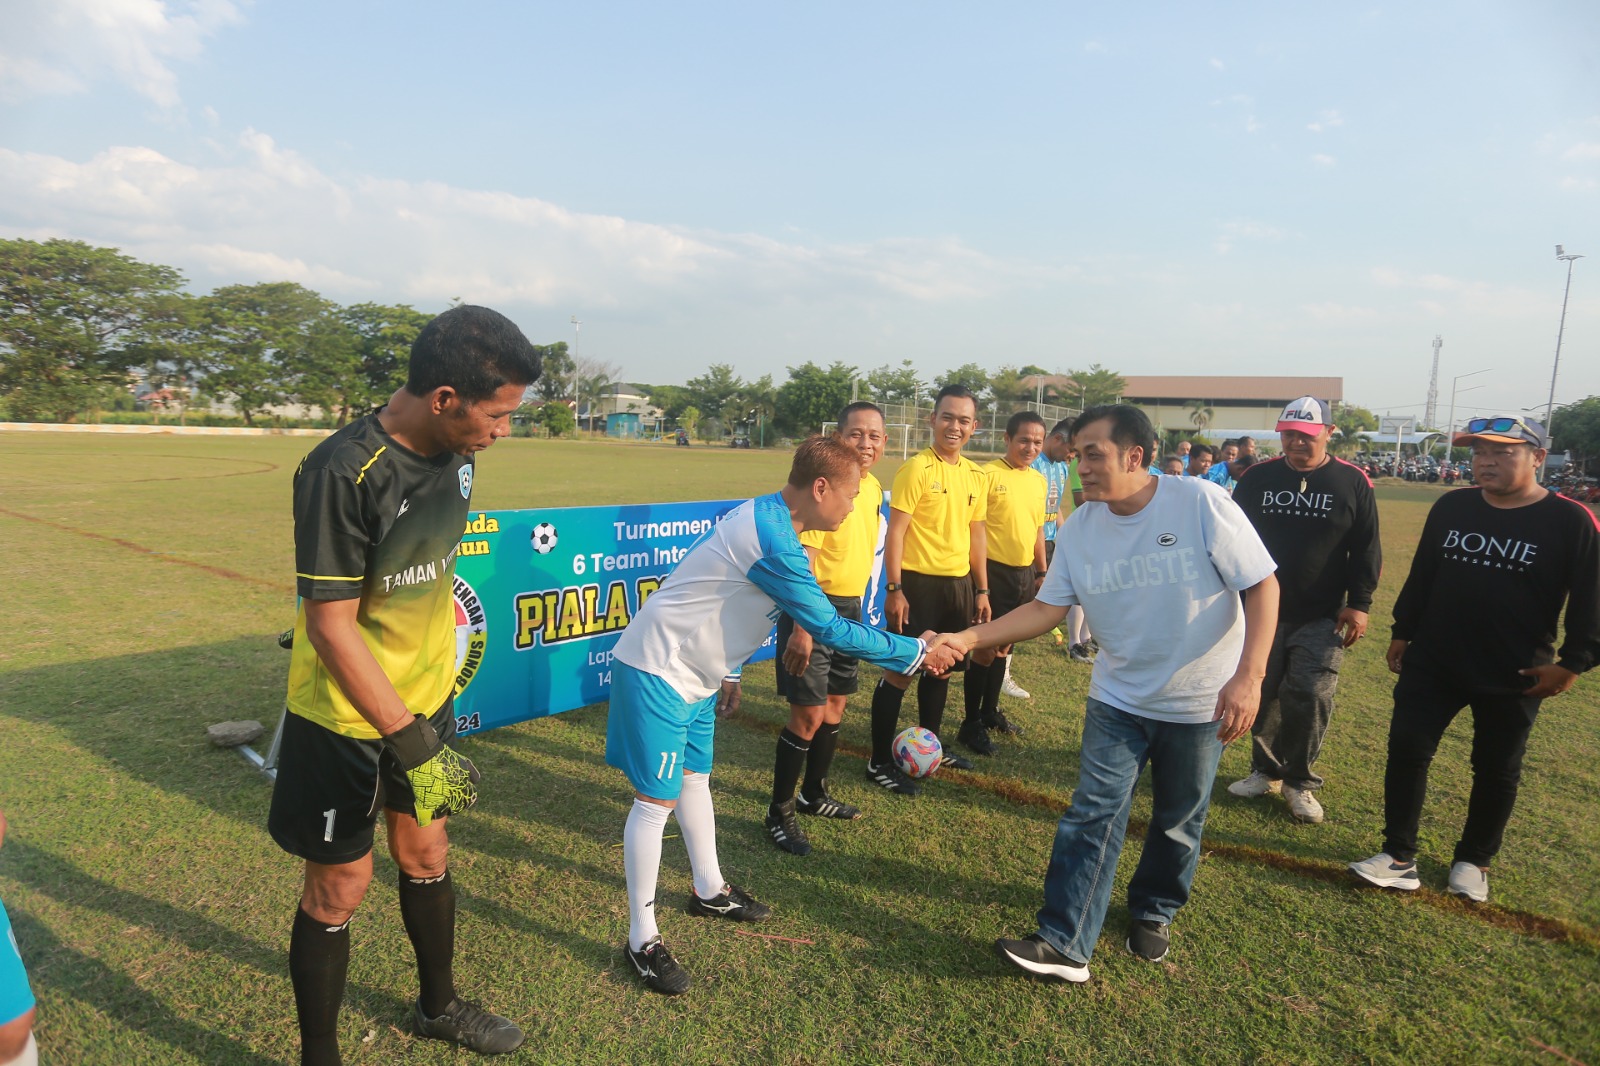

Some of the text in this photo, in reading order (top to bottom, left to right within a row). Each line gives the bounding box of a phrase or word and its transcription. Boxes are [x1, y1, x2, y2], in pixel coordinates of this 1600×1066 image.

[1285, 410, 1314, 421] FILA
[1261, 490, 1333, 511] BONIE
[1262, 509, 1327, 519] LAKSMANA
[613, 518, 712, 541] Turnamen
[1442, 529, 1538, 565] BONIE
[383, 560, 438, 593] TAMAN
[573, 554, 586, 575] 6
[591, 551, 649, 573] Team
[1084, 547, 1199, 595] LACOSTE
[1443, 553, 1525, 573] LAKSMANA
[515, 581, 631, 649] PIALA
[455, 640, 484, 688] BONUS
[657, 751, 678, 779] 11
[323, 808, 337, 842] 1
